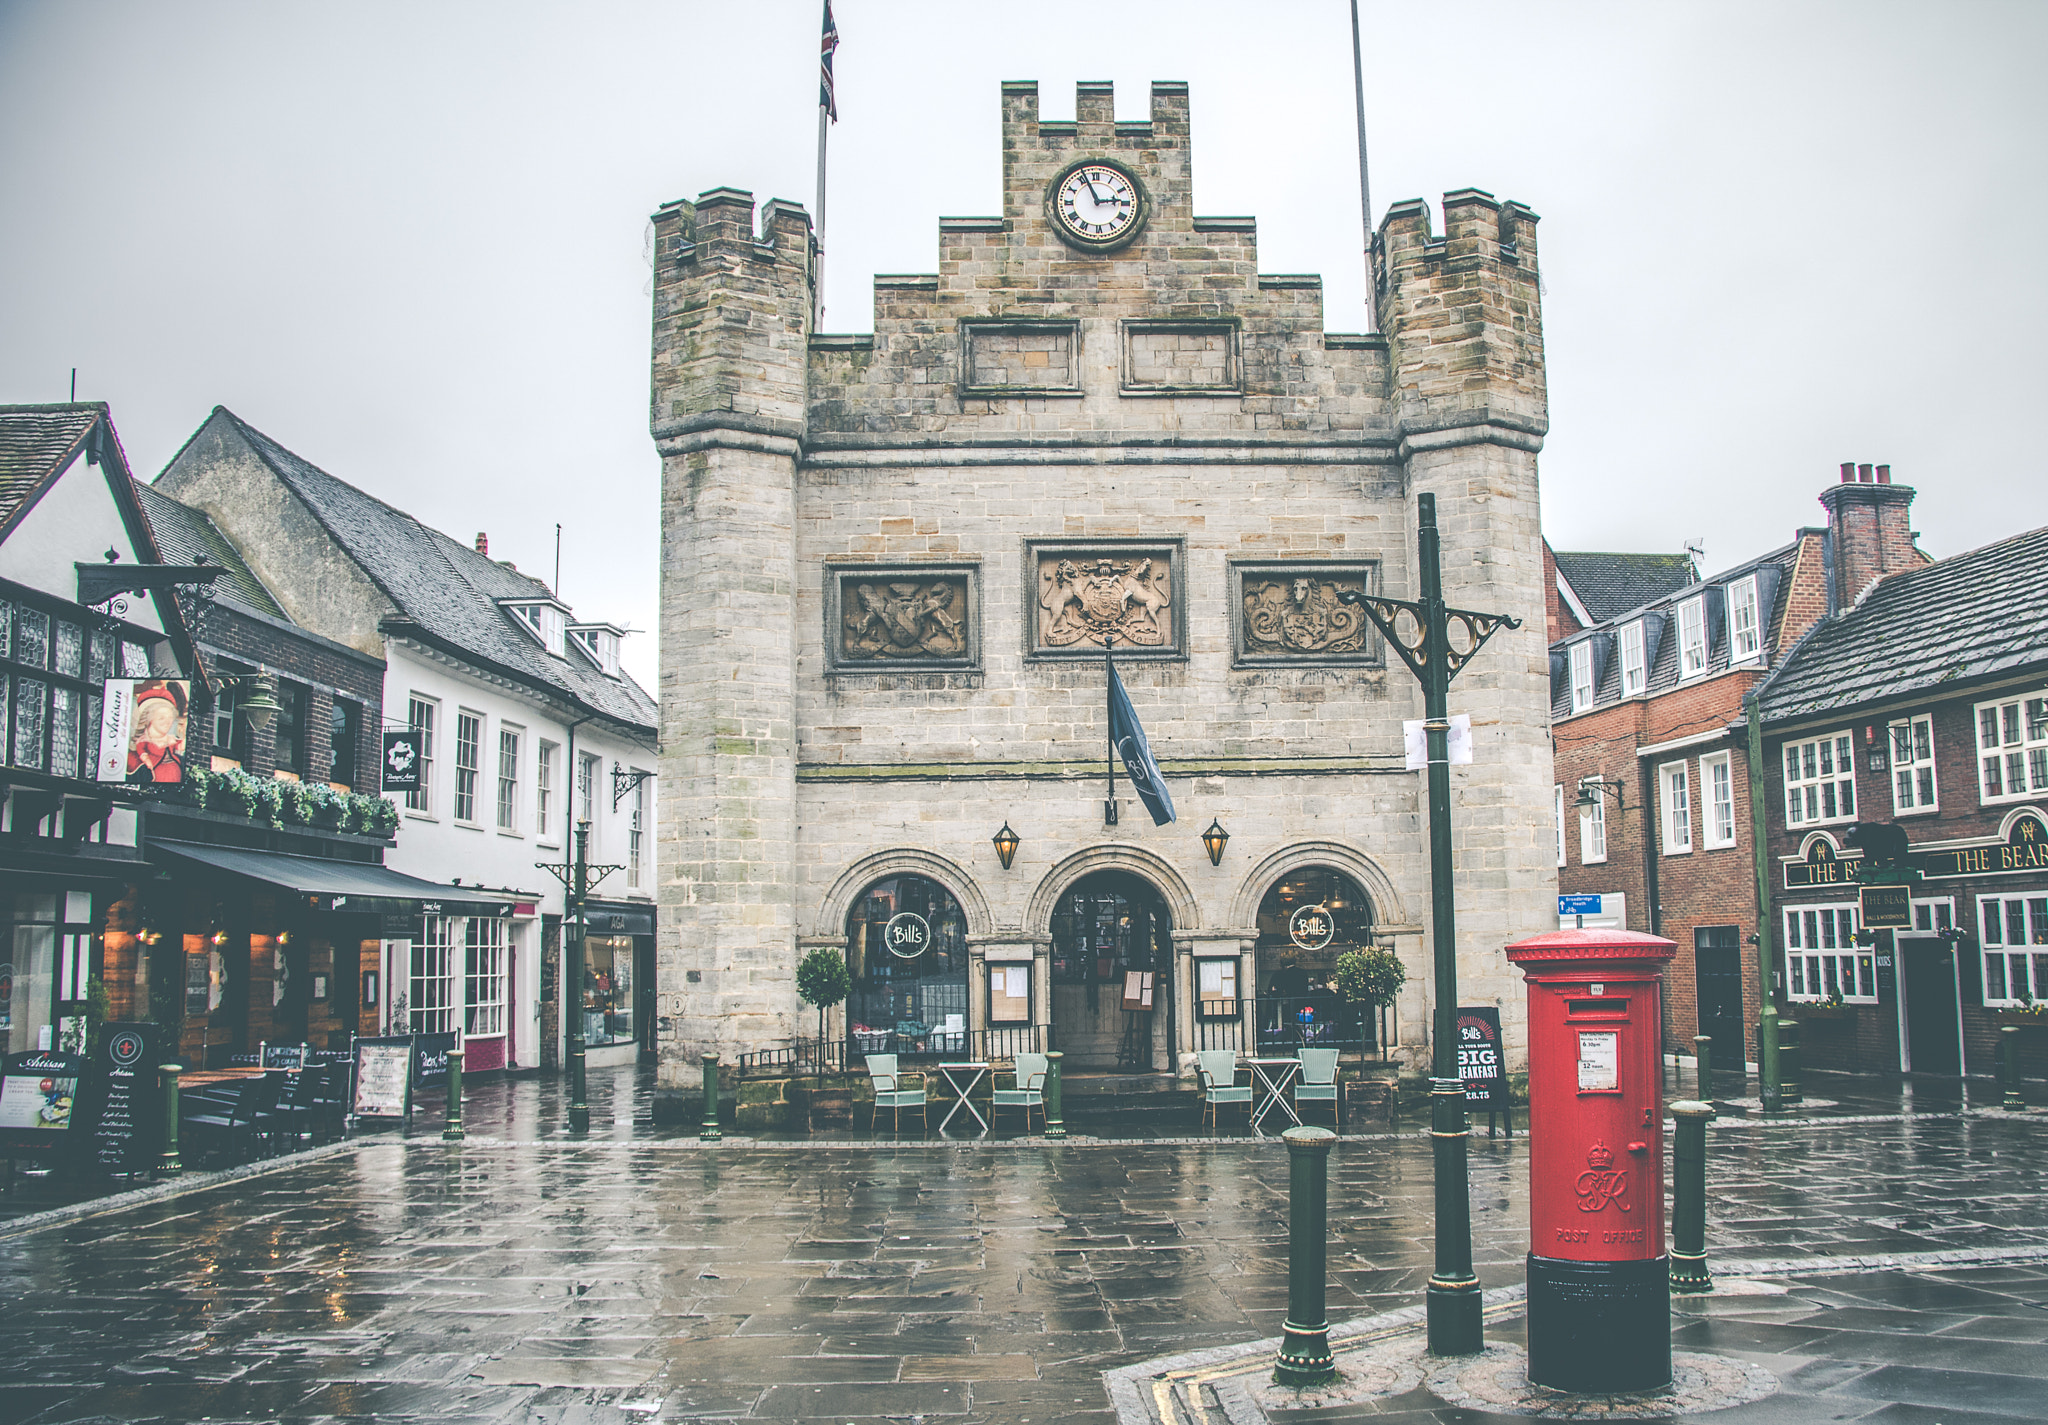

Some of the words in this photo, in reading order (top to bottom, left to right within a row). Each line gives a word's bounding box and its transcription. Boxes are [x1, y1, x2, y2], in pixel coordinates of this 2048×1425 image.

[105, 690, 122, 748] Artisan
[1952, 849, 1990, 872] THE
[2000, 843, 2048, 869] BEAR
[1805, 862, 1837, 883] THE
[1864, 896, 1881, 905] THE
[1884, 895, 1906, 904] BEAR
[610, 916, 625, 929] AGA
[1297, 916, 1327, 937] Bill's
[893, 924, 922, 944] Bill's
[1461, 1026, 1481, 1040] Bill's
[19, 1054, 66, 1069] Artisan
[1457, 1049, 1498, 1065] BIG
[1556, 1227, 1589, 1243] POST
[1602, 1228, 1643, 1244] OFFICE
